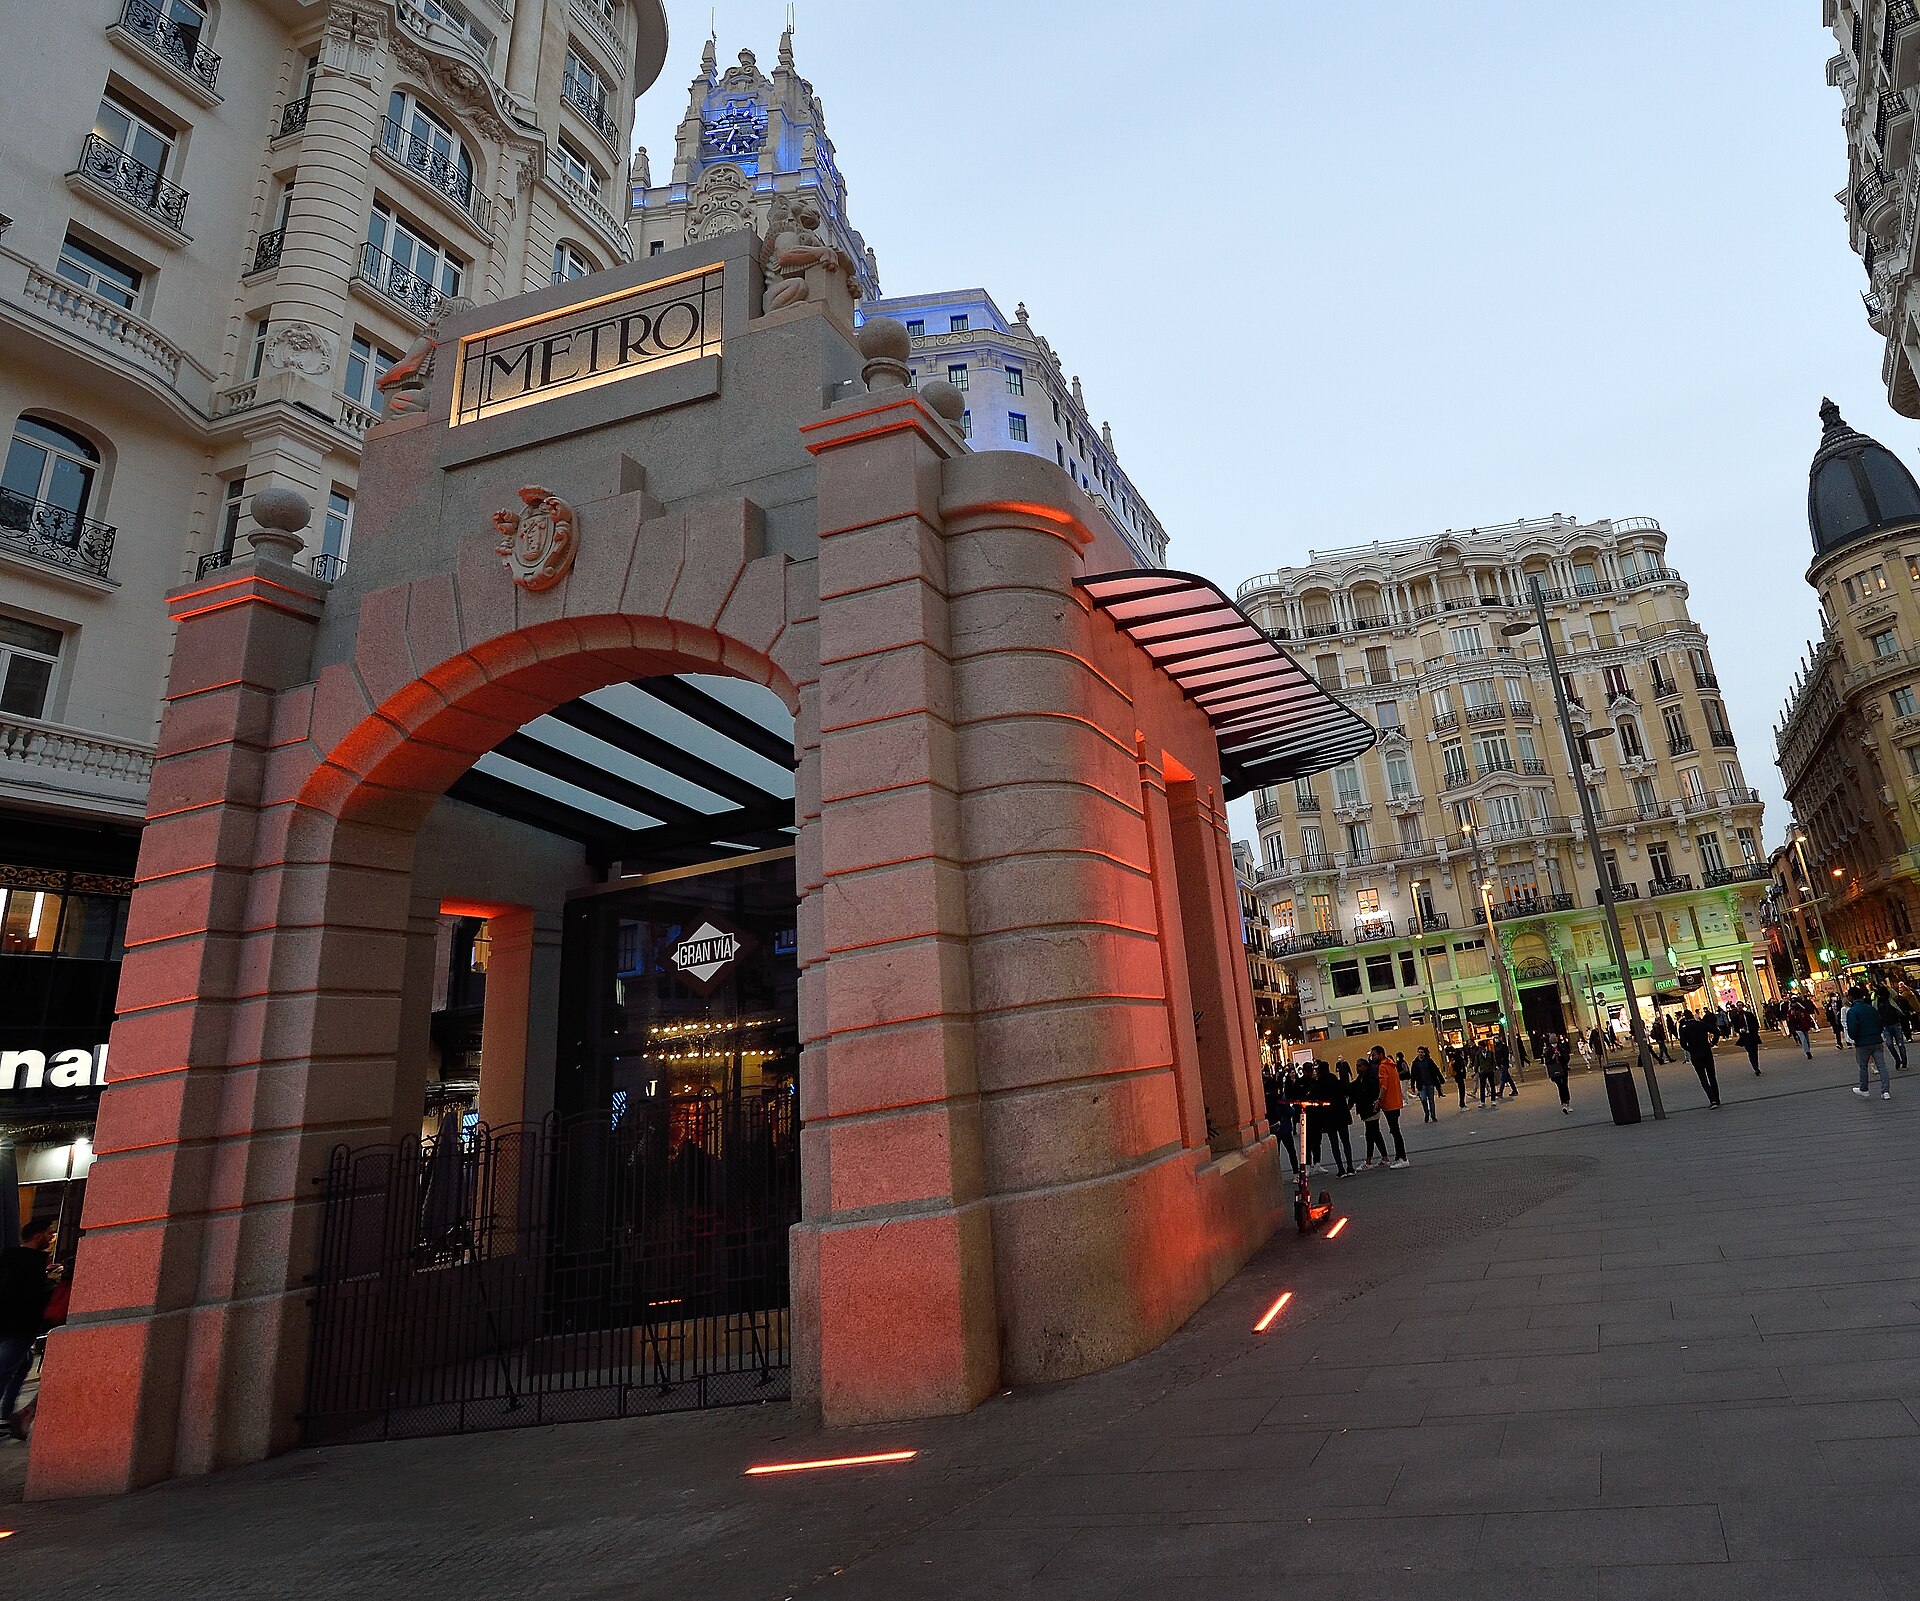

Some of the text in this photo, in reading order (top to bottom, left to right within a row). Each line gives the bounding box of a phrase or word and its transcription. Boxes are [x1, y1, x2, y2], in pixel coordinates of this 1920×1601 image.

[482, 302, 701, 403] METRO
[680, 936, 732, 966] GRAN VÍA
[1583, 965, 1648, 983] ARMCIA
